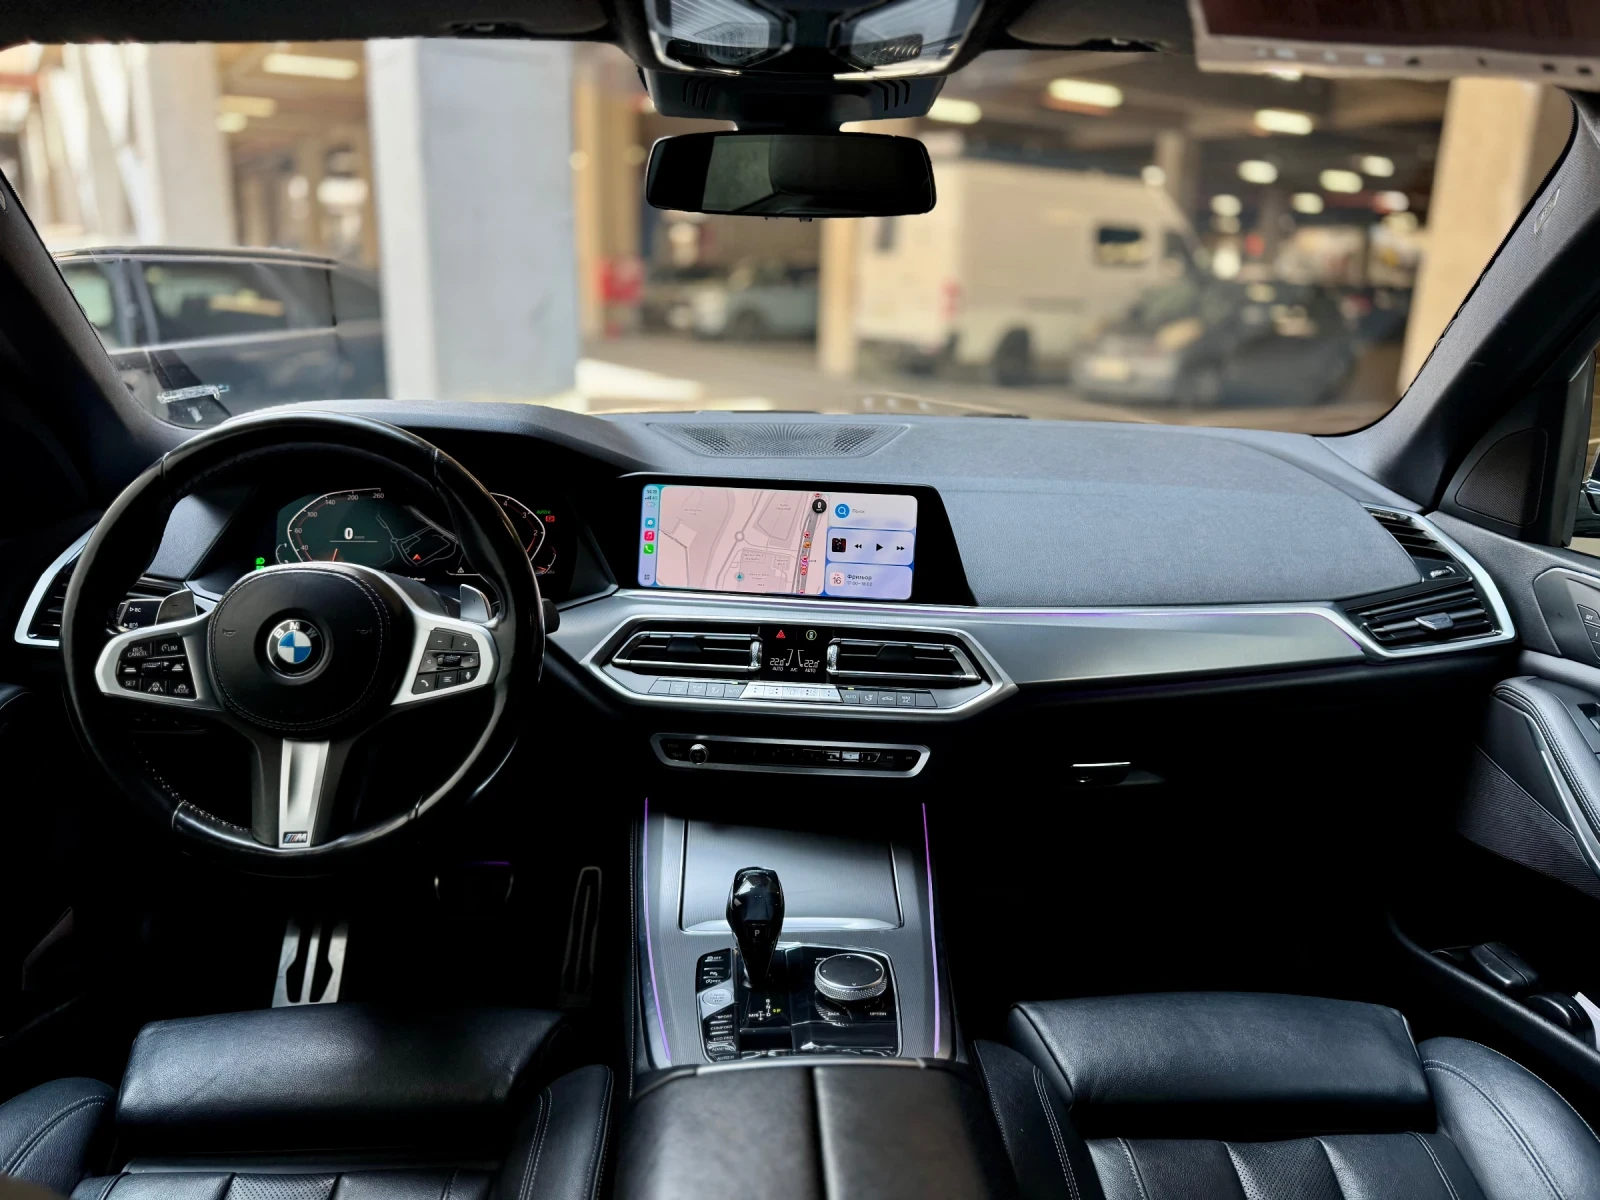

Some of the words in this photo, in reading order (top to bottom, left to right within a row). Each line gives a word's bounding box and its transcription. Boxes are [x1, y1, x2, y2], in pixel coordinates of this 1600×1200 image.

[344, 527, 354, 540] 0
[533, 529, 538, 537] 2
[832, 576, 842, 585] 16
[273, 621, 318, 639] BMW
[754, 929, 760, 937] P
